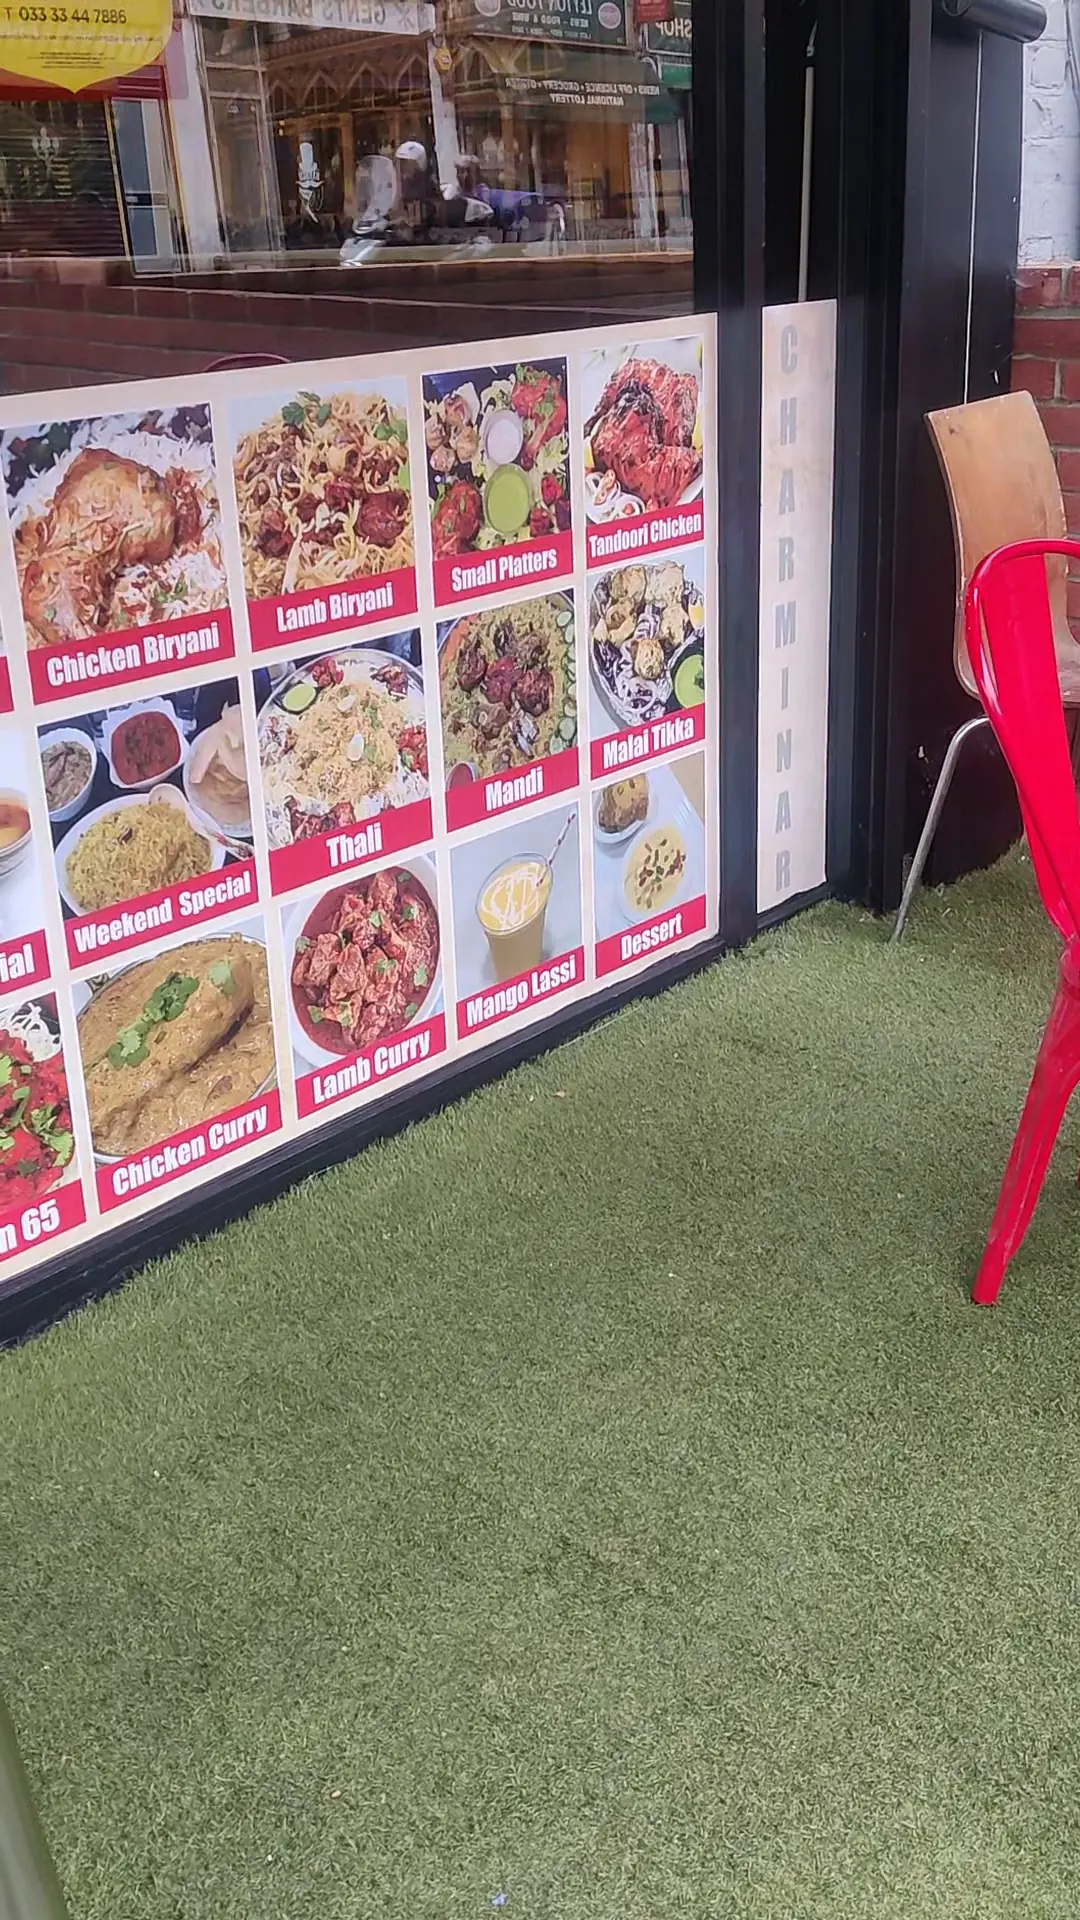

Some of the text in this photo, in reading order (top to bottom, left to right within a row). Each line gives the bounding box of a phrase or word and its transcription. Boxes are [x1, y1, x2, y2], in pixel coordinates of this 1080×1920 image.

[3, 6, 127, 24] T 033 33 44 7886
[589, 513, 702, 558] Tandoori Chicken
[451, 549, 558, 592] Small Platters
[276, 582, 394, 632] Lamb Biryani
[774, 324, 798, 893] CHARMINAR
[47, 622, 220, 687] Chicken Biryani
[602, 717, 695, 770] Malai Tikka
[485, 766, 544, 812] Mandi
[325, 822, 384, 868] Thali
[73, 871, 252, 954] Weekend Special
[620, 913, 683, 961] Dessert
[466, 954, 577, 1028] Mango Lassi
[312, 1028, 431, 1105] Lamb Curry
[112, 1103, 269, 1197] Chicken Curry
[20, 1198, 60, 1241] 65
